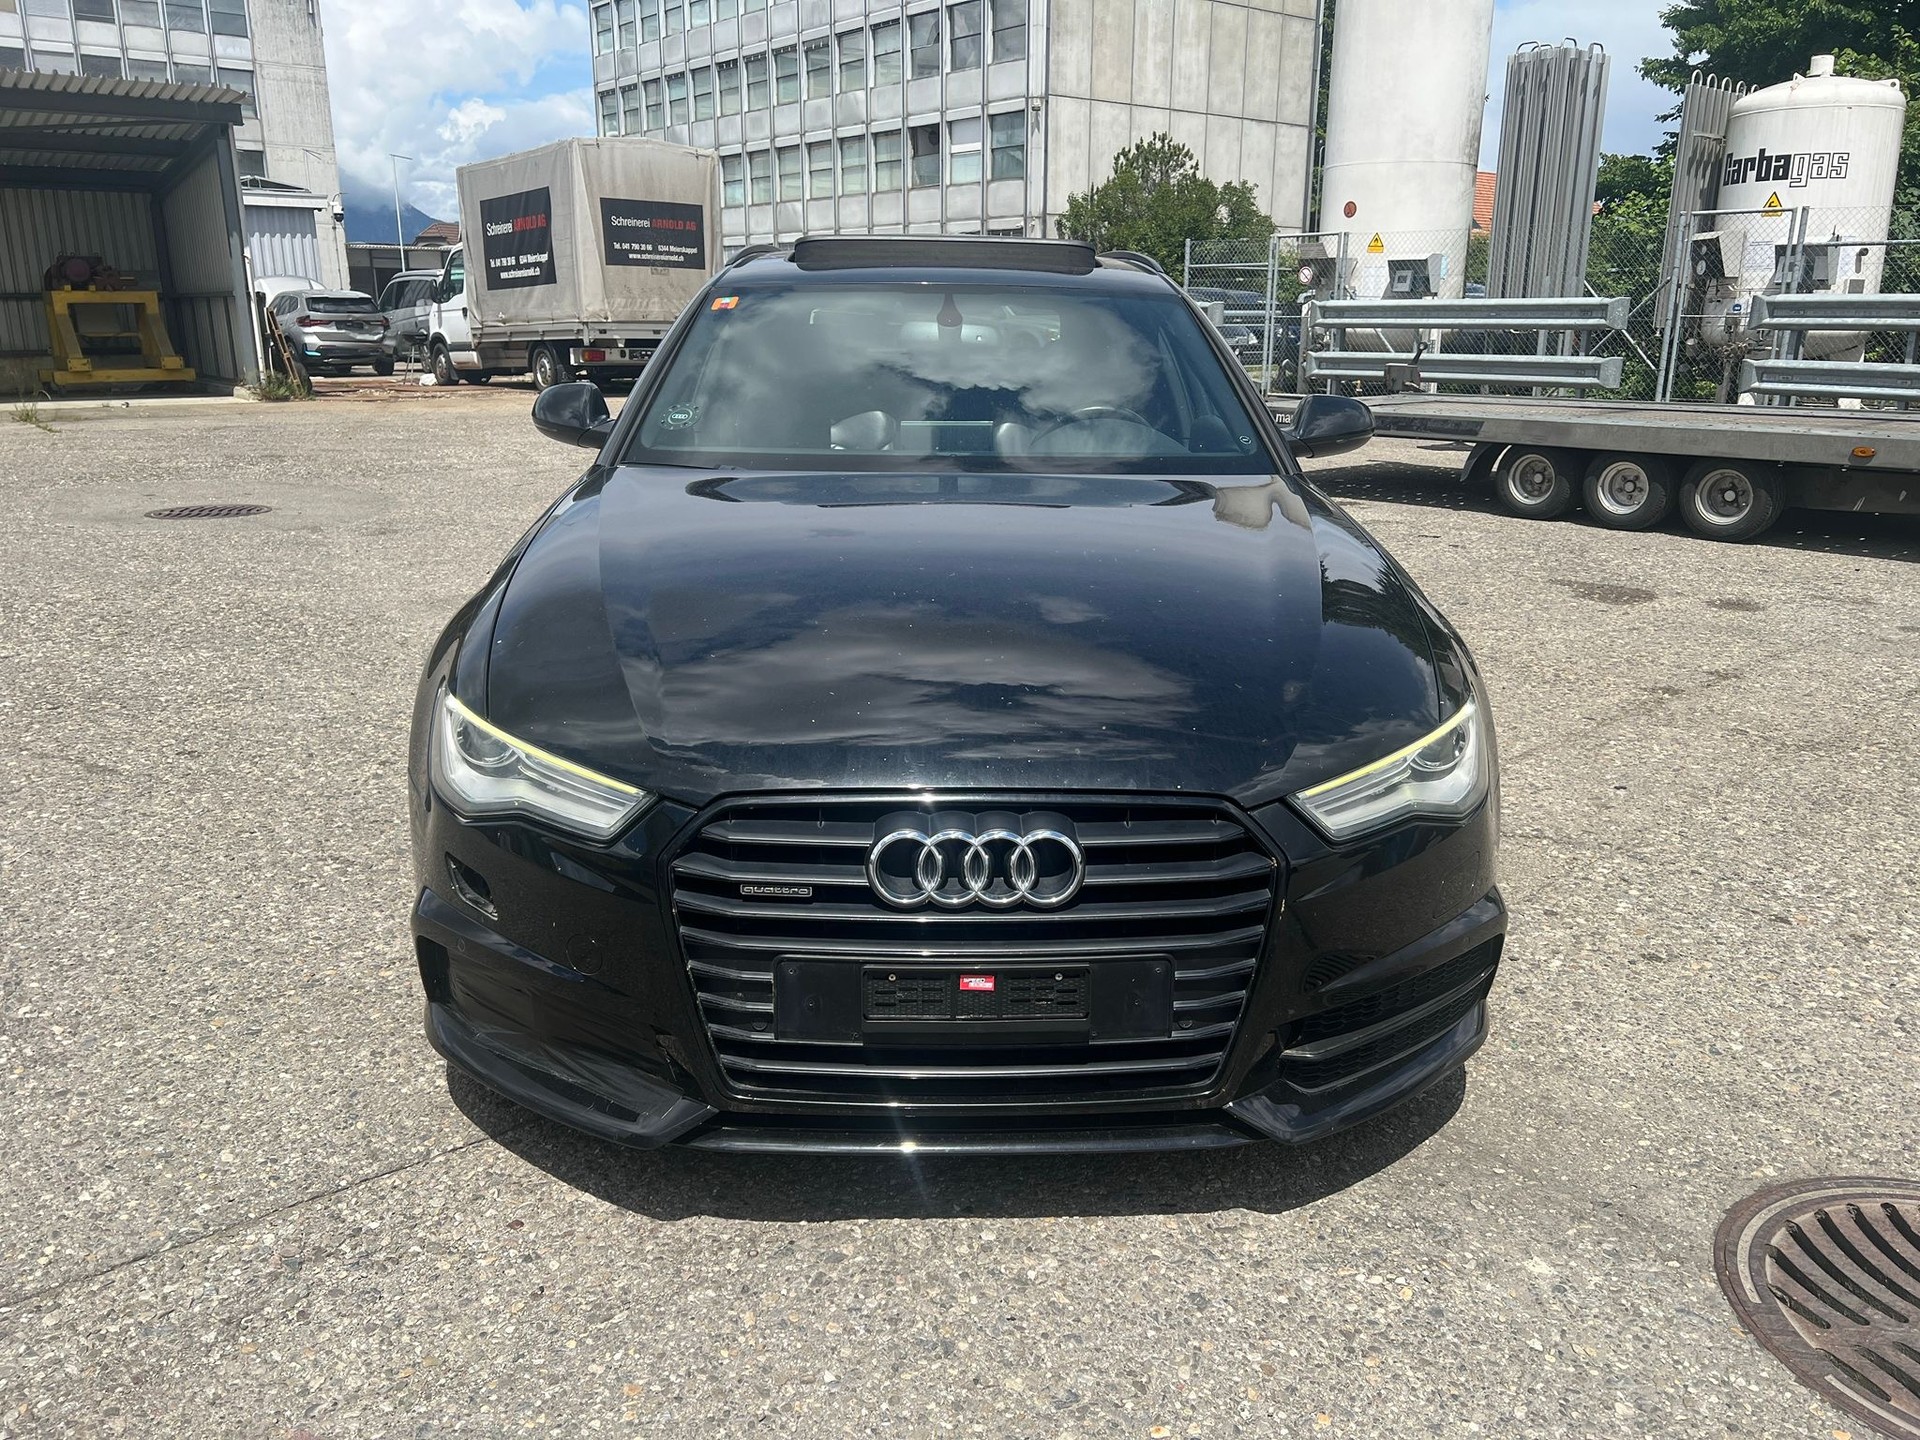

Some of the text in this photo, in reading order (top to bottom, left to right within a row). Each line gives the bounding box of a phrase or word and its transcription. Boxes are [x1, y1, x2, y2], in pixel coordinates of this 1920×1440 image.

[1723, 148, 1850, 188] Carbagas
[486, 219, 513, 237] Schreinerei
[611, 215, 697, 231] Schreinerei ARNOLD AG
[743, 886, 808, 895] quattro
